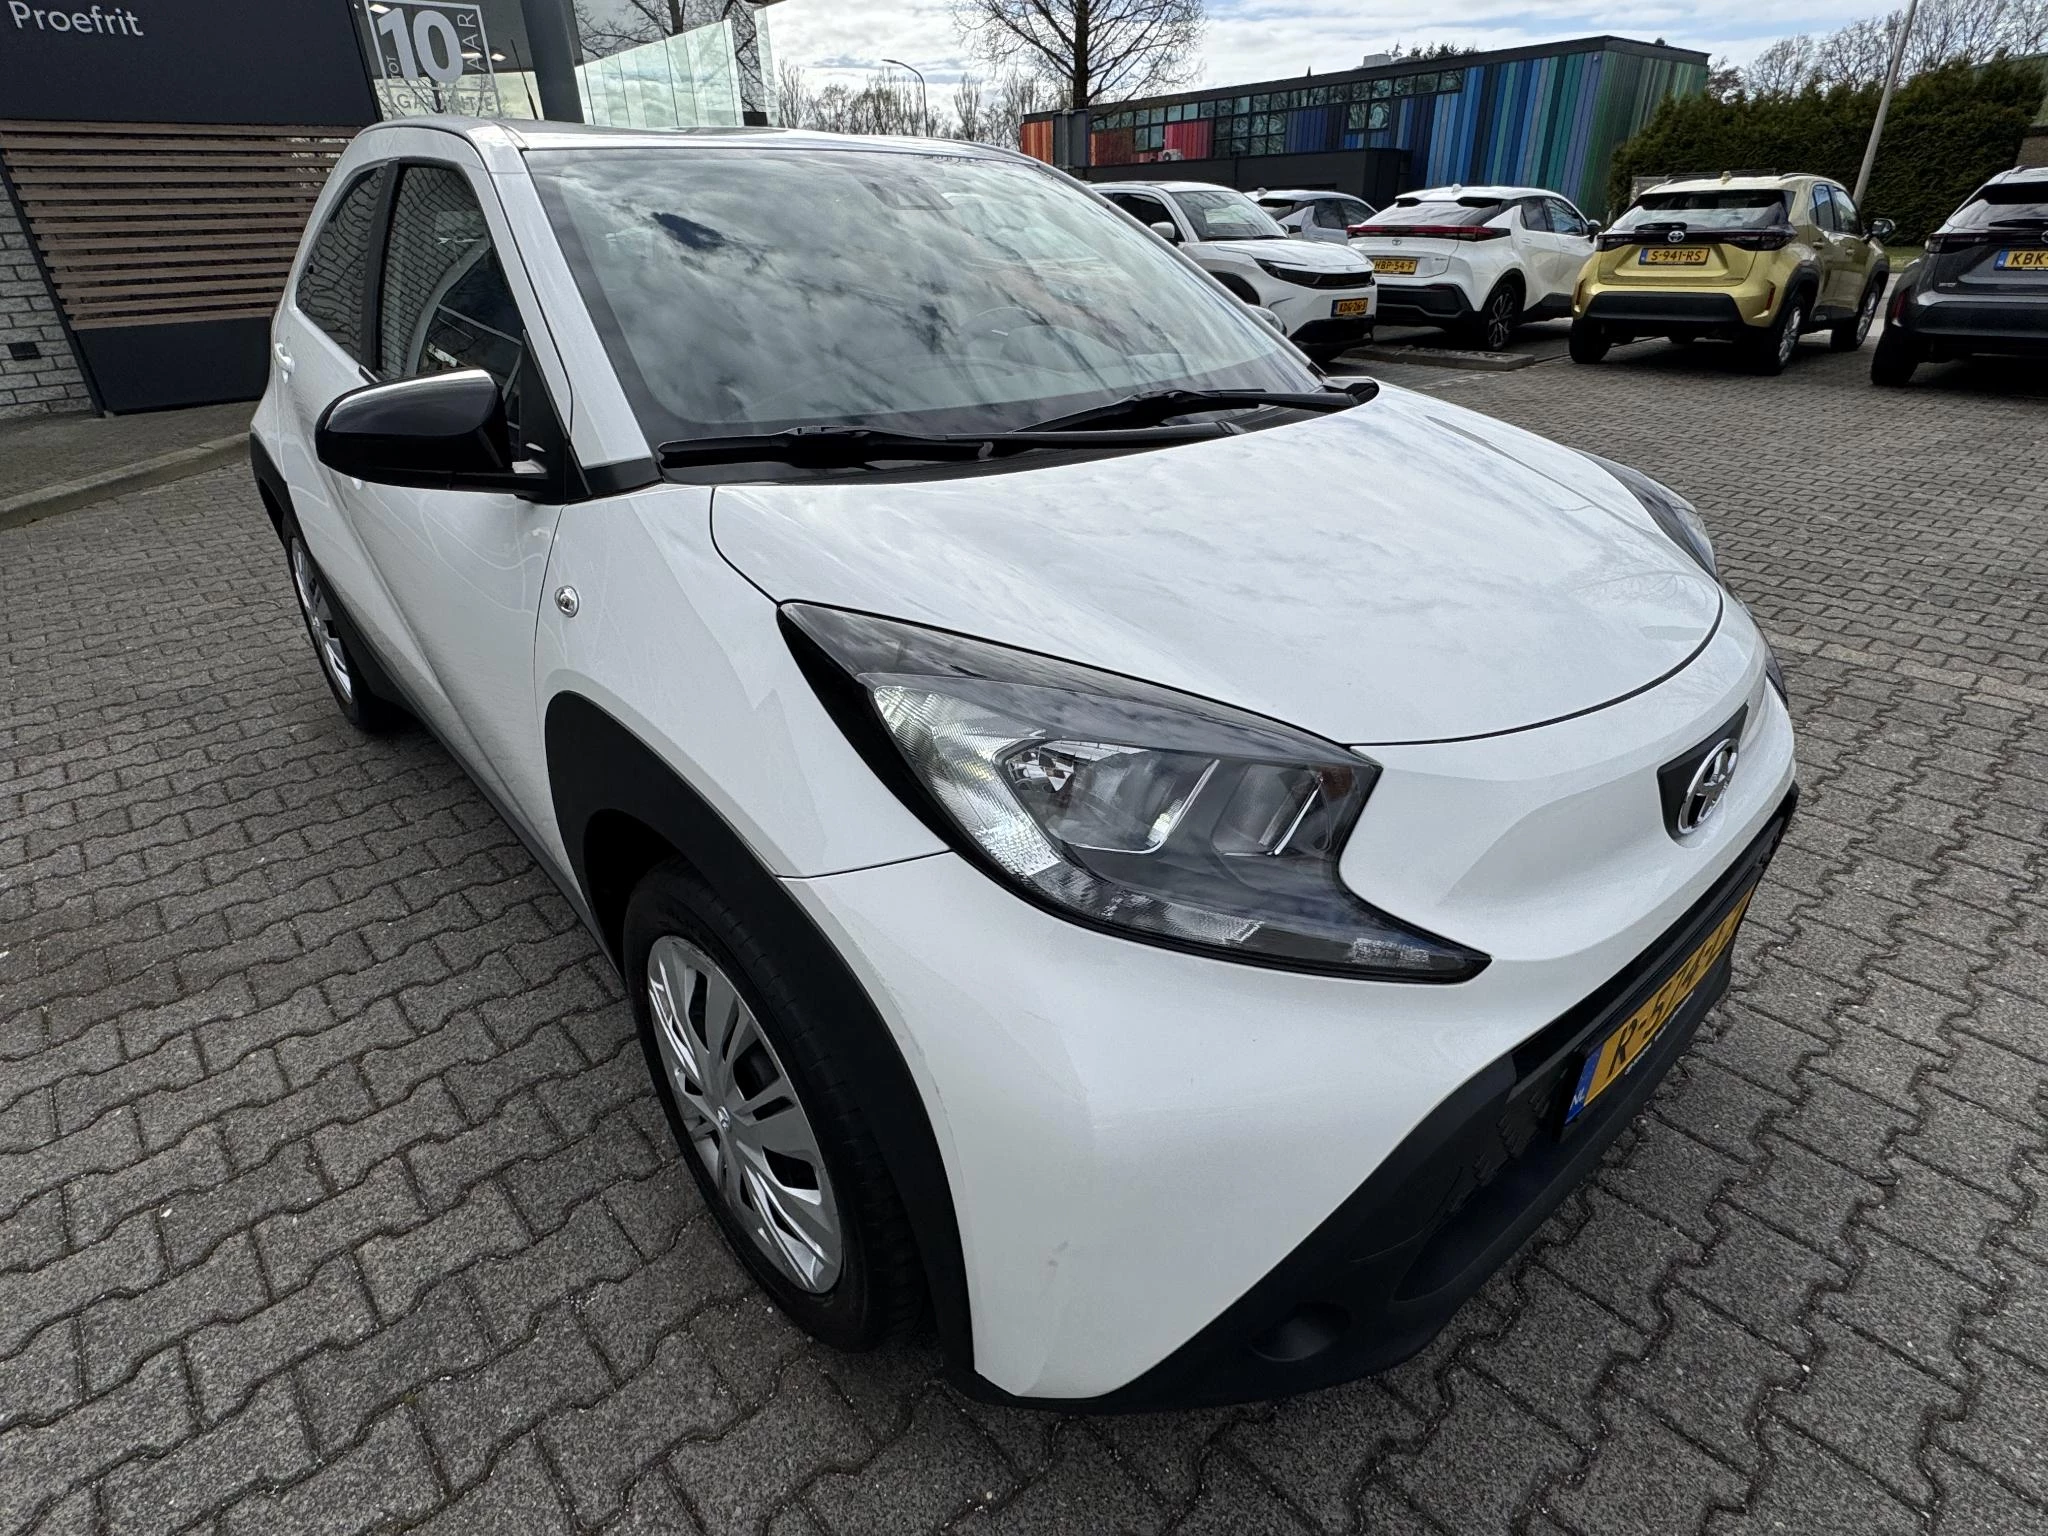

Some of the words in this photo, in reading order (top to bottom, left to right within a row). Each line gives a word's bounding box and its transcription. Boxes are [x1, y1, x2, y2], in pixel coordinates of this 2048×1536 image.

[8, 0, 144, 36] Proefrit
[377, 7, 464, 83] 10
[456, 13, 487, 76] AAR
[1650, 250, 1703, 262] S-941-RS
